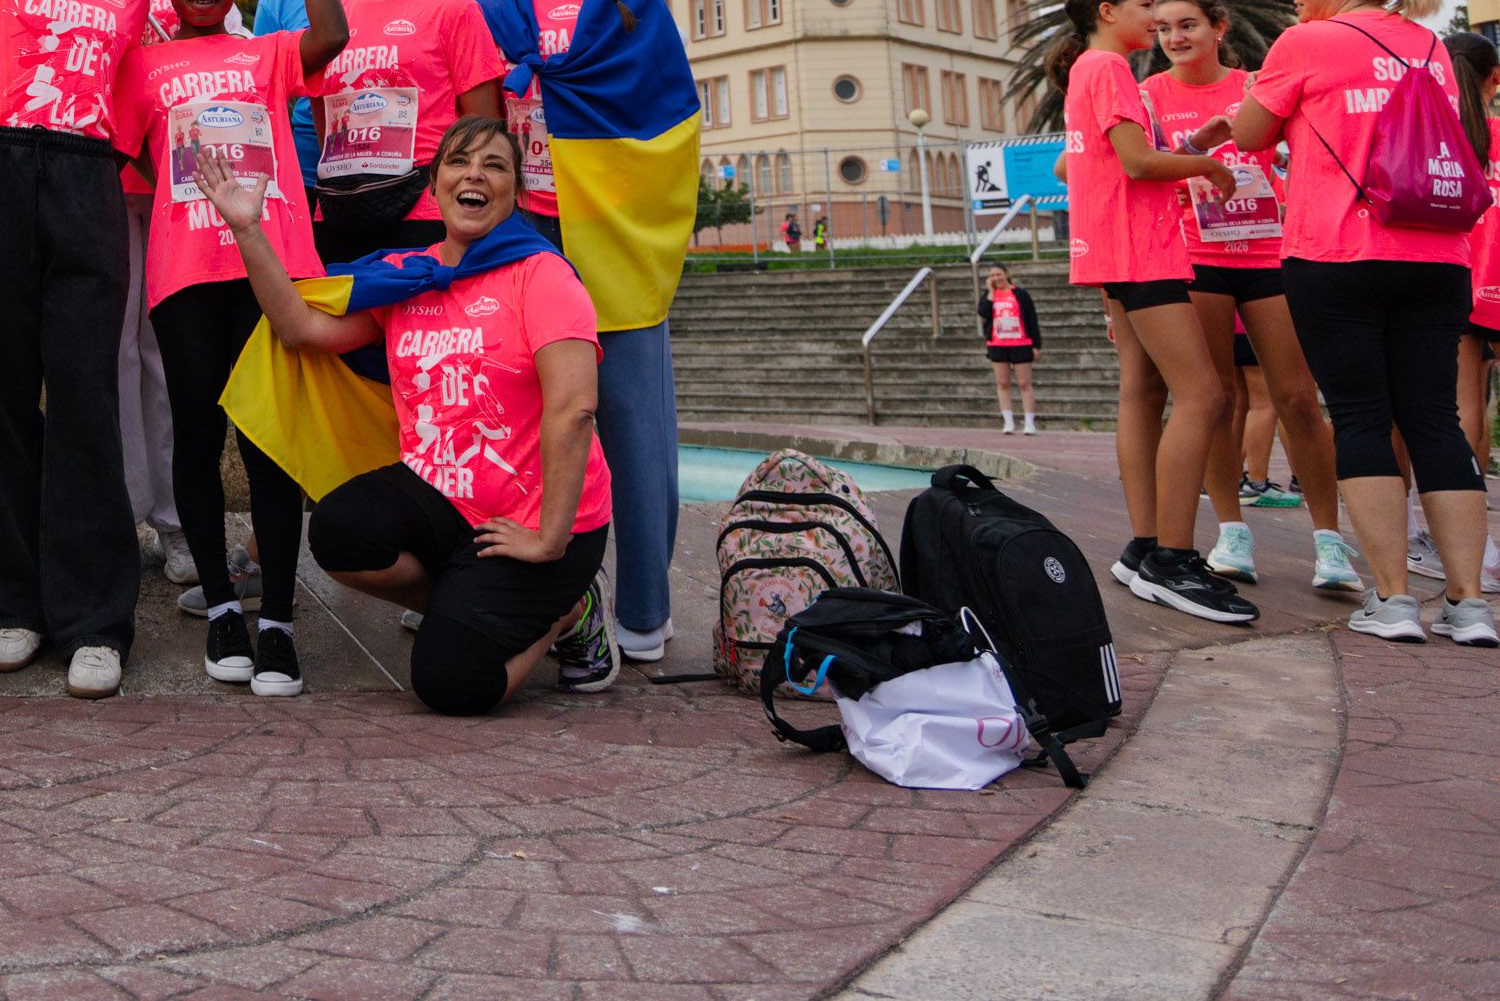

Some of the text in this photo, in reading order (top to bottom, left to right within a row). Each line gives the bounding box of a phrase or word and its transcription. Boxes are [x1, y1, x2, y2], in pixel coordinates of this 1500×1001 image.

[65, 36, 103, 77] DE
[148, 60, 190, 80] OYSHO
[160, 70, 257, 109] CARRERA
[353, 101, 385, 111] ASTURIANA
[201, 114, 241, 123] ASTURIANA
[1161, 111, 1198, 122] OYSHO
[348, 127, 381, 143] 016
[326, 164, 352, 173] OYSHO
[1432, 178, 1462, 198] ROSA
[1225, 198, 1258, 213] 016
[1223, 241, 1249, 252] 2026
[403, 305, 444, 316] OYSHO
[396, 326, 484, 358] CARRERA
[442, 365, 469, 406] DE
